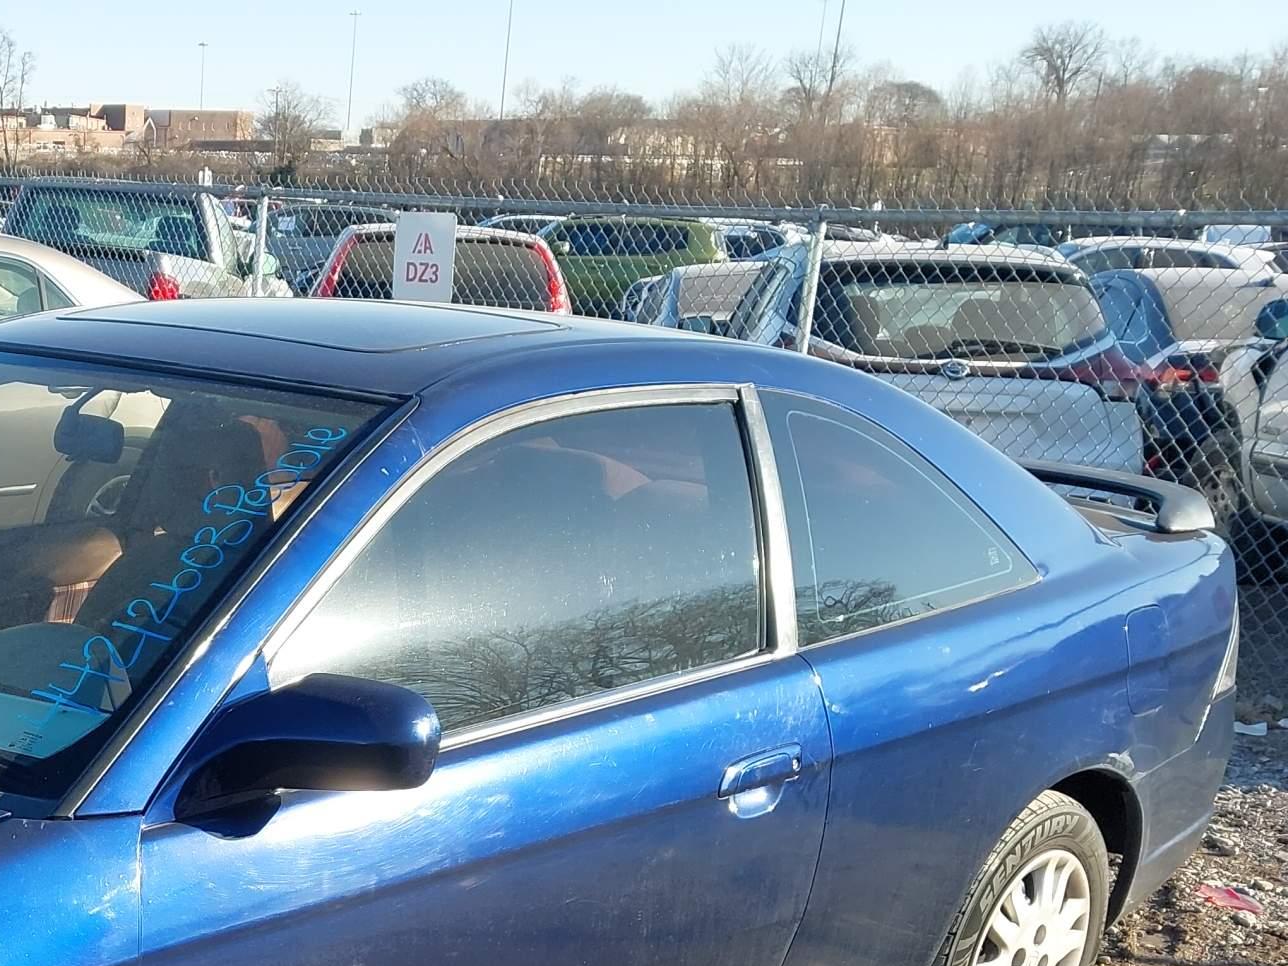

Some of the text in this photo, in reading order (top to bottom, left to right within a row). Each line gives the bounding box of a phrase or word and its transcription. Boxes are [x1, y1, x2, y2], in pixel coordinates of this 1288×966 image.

[406, 261, 440, 284] DZ3
[31, 518, 253, 722] 44212603
[979, 814, 1081, 916] SENTURY
